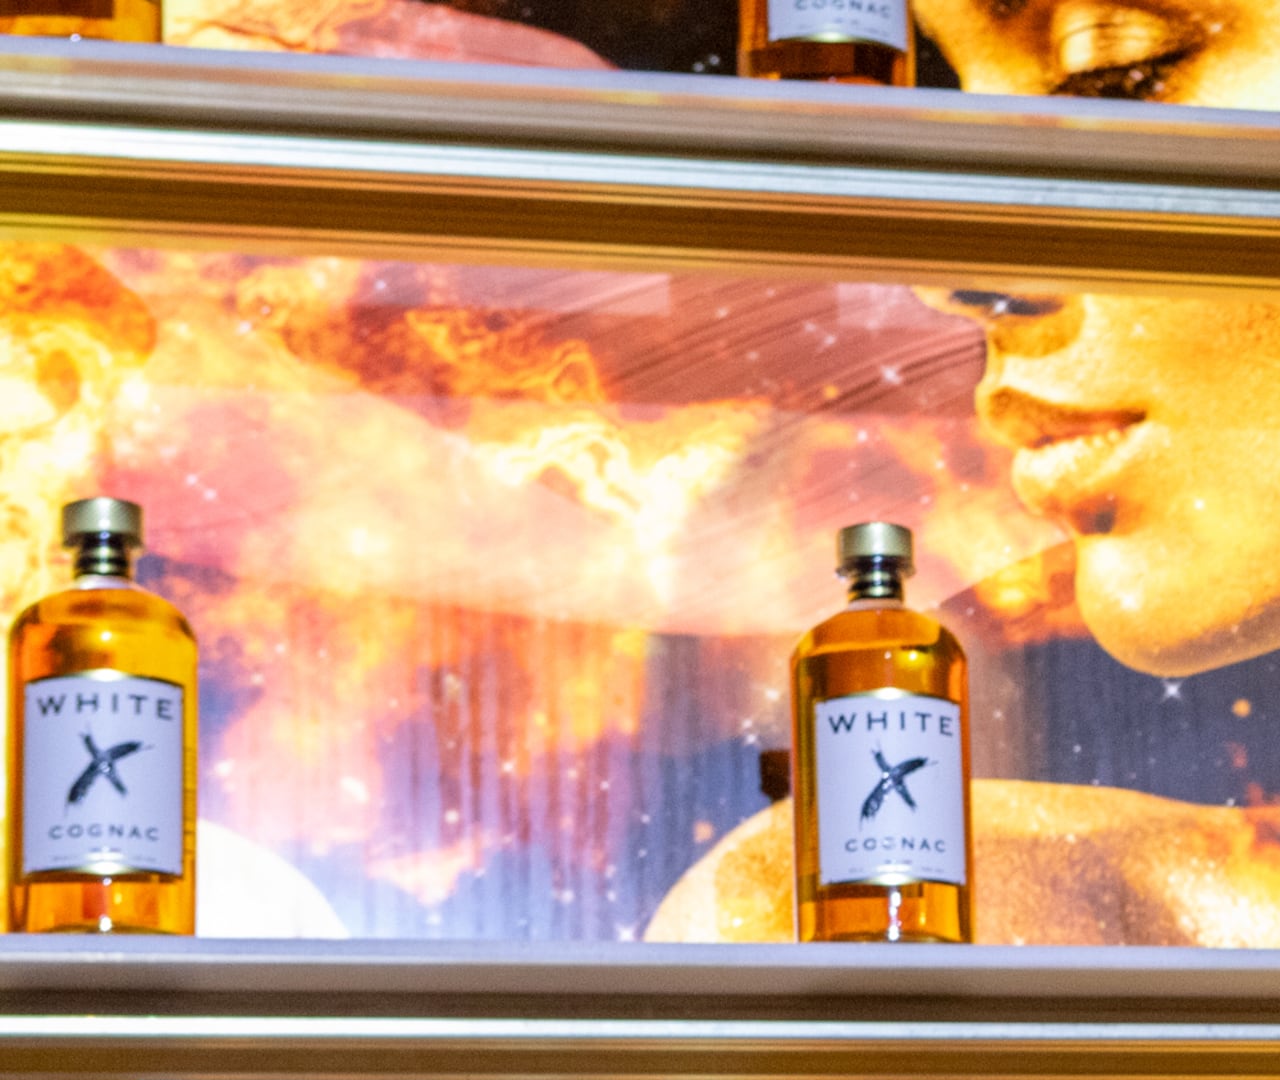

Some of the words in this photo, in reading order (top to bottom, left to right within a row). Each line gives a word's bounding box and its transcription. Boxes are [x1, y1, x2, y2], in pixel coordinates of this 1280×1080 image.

[37, 692, 173, 721] WHITE
[828, 711, 954, 737] WHITE
[65, 726, 152, 811] X
[859, 743, 936, 827] X
[48, 824, 159, 842] COGNAC
[844, 837, 947, 853] COGNAC
